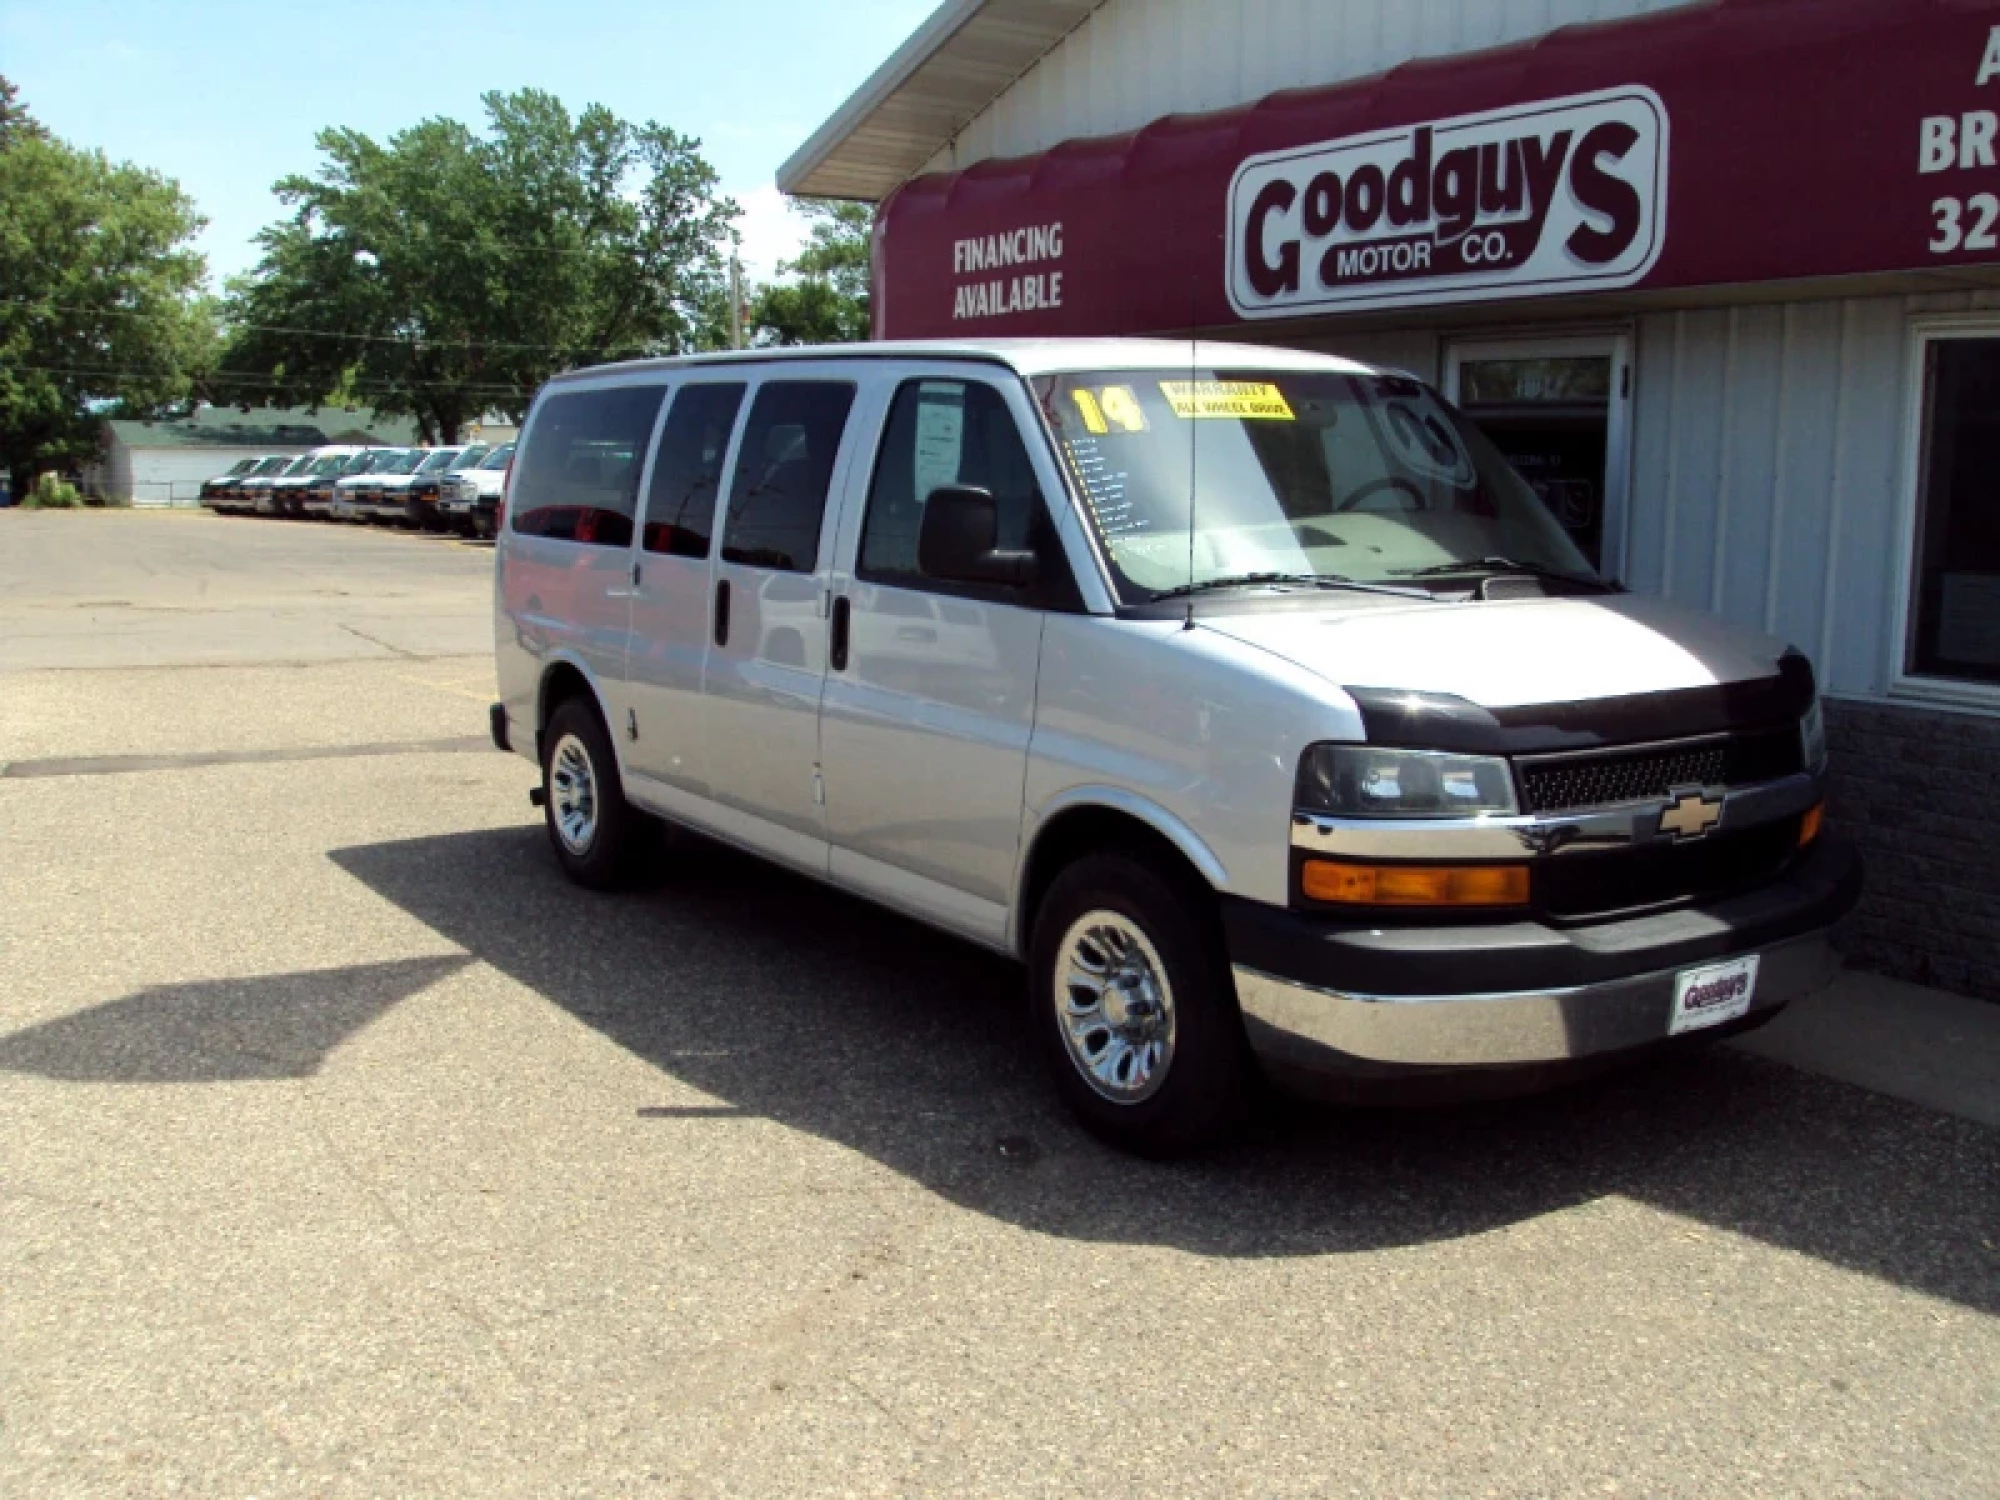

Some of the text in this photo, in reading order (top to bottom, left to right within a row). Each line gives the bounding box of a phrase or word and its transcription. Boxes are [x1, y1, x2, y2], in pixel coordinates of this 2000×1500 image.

[954, 221, 1063, 274] FINANCING
[1336, 231, 1514, 277] MOTOR CO.
[952, 270, 1063, 319] AVAILABLE
